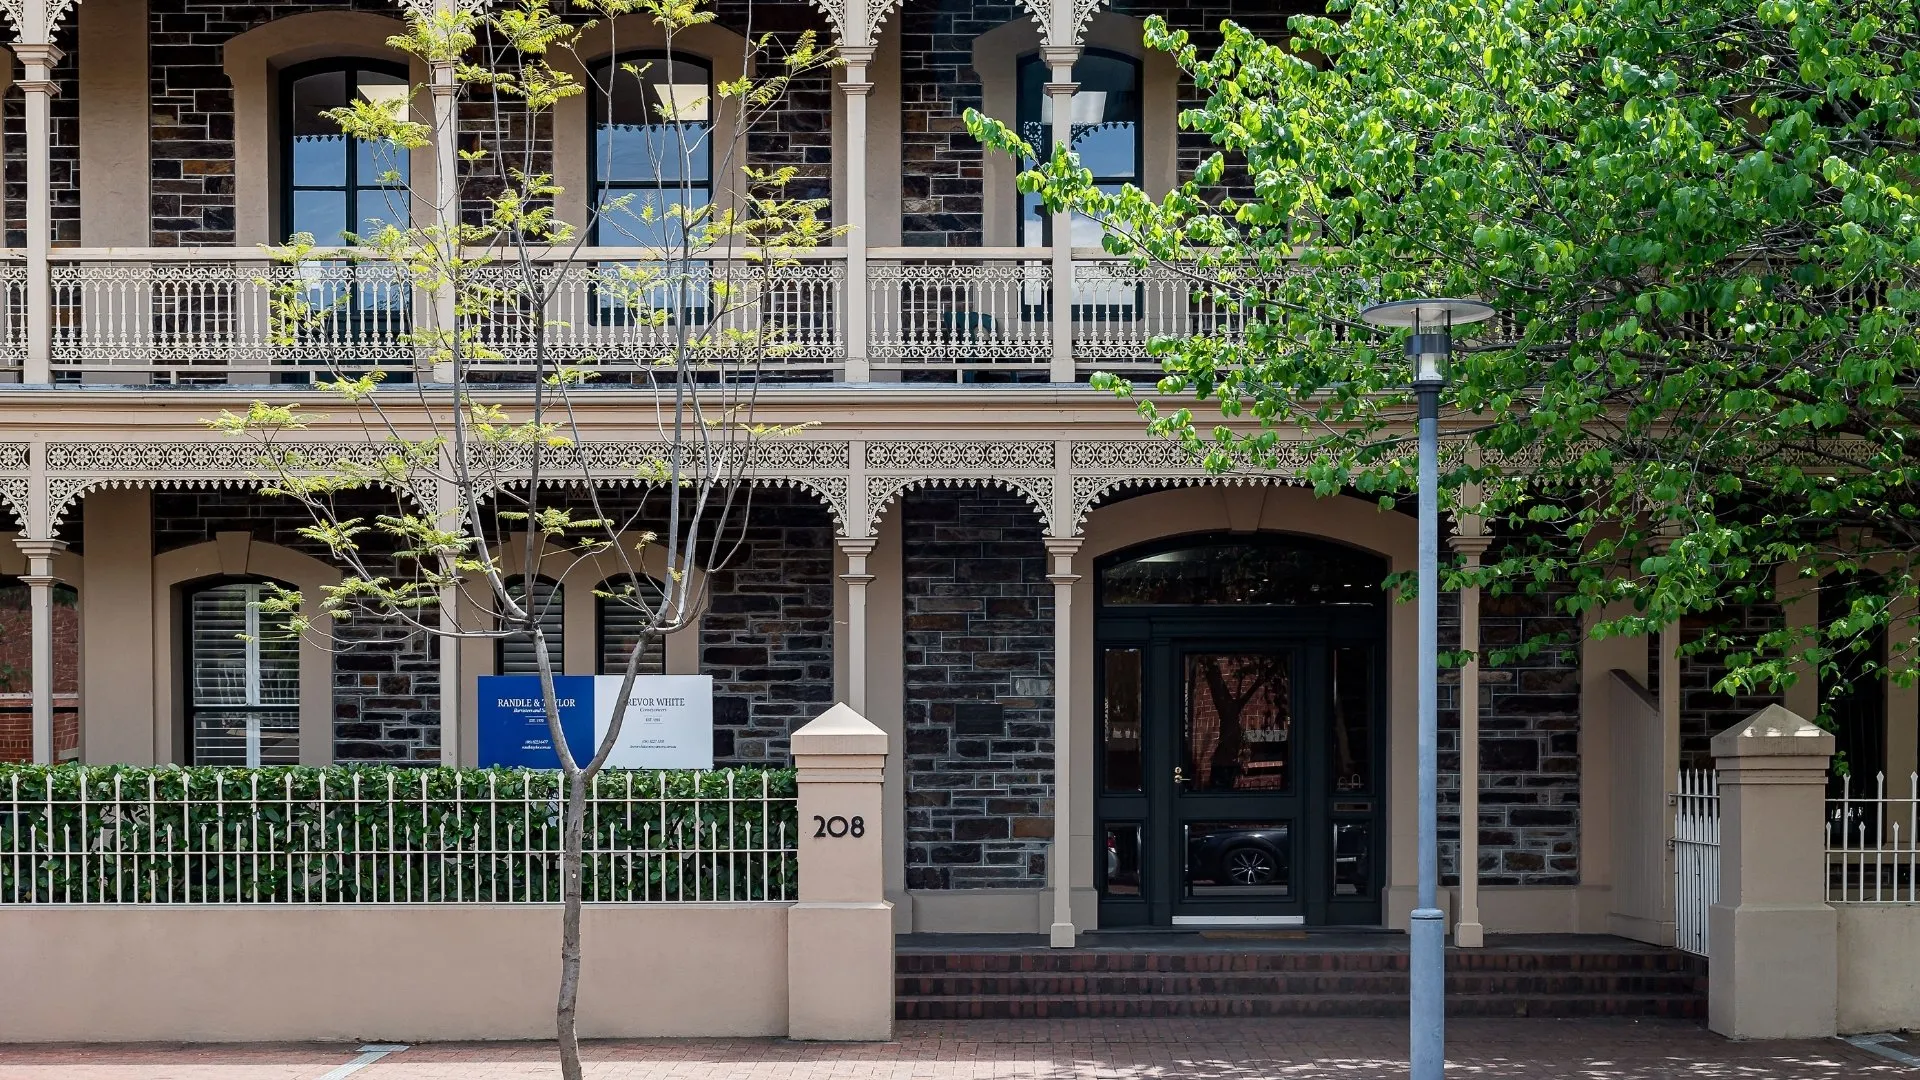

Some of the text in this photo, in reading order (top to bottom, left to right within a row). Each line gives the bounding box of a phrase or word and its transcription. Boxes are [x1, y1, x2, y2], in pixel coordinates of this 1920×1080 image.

[498, 699, 532, 707] RANDLE
[533, 699, 540, 707] &
[656, 697, 685, 706] WHITE
[813, 815, 865, 838] 208
